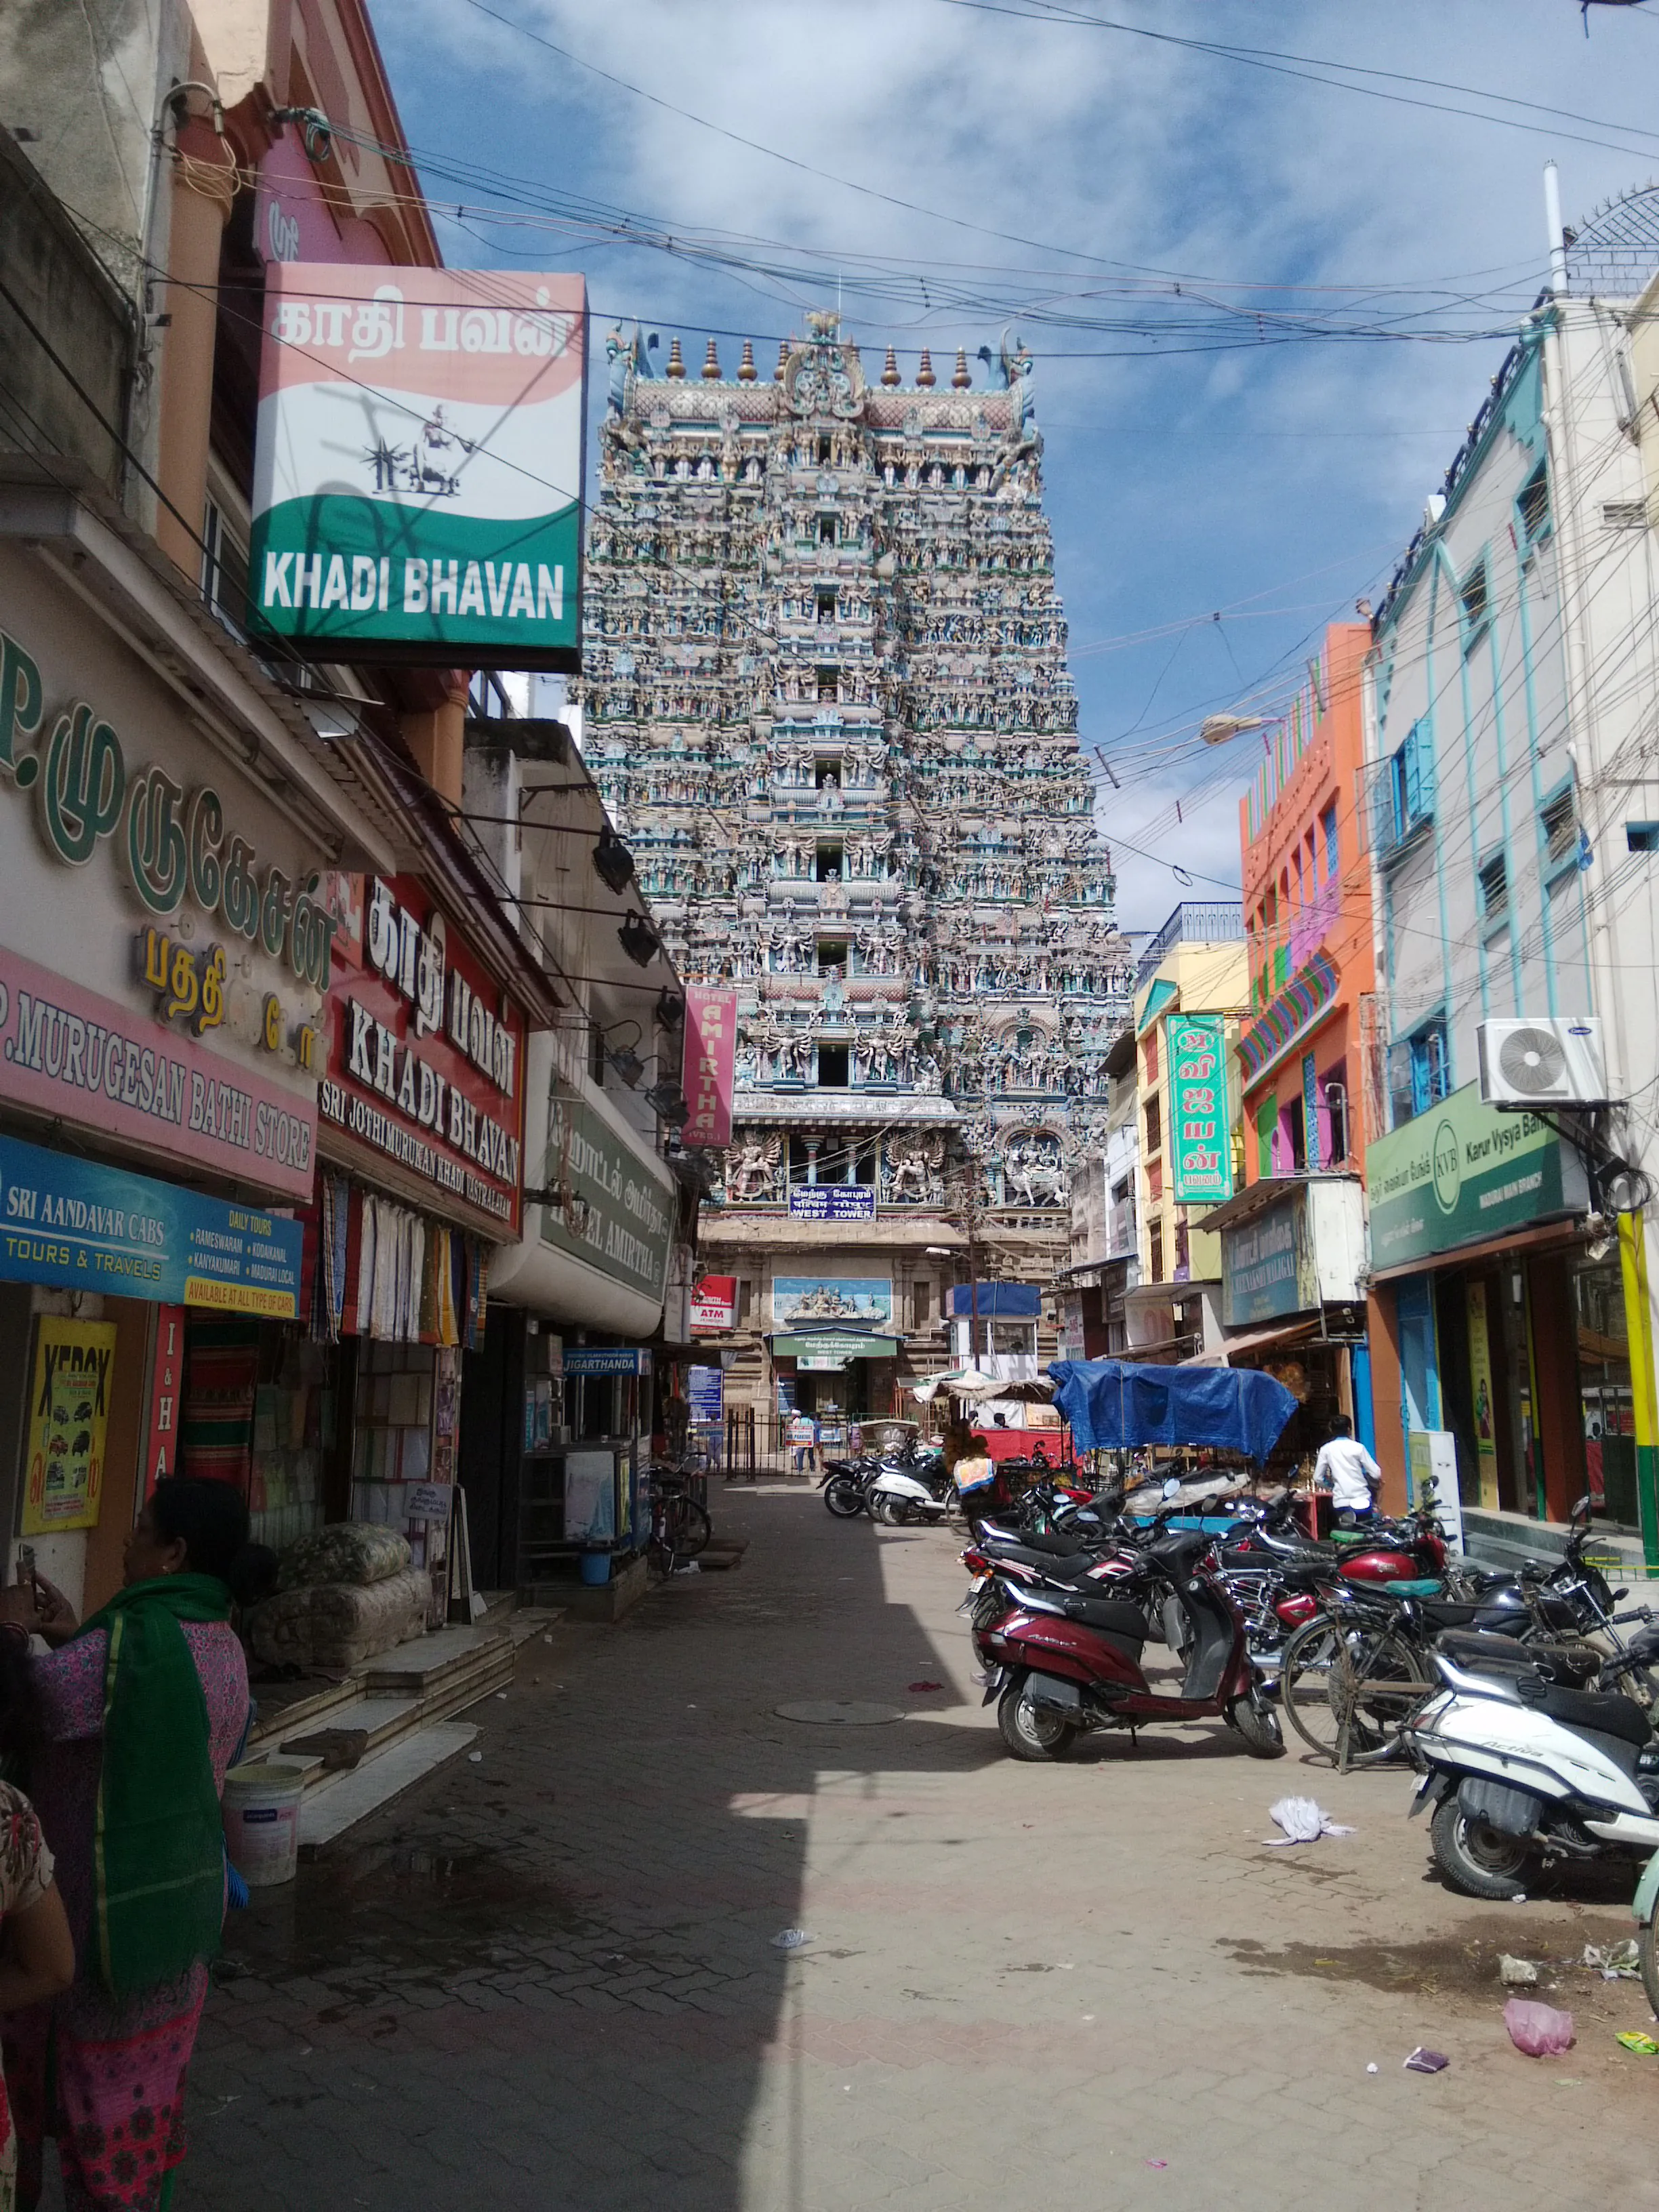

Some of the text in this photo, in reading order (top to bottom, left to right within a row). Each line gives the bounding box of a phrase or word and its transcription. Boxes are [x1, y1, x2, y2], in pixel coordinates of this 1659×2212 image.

[272, 284, 576, 364] காதி பவன்
[264, 551, 565, 619] KHADI BHAVAN
[369, 876, 516, 1099] காதி பவன்
[694, 991, 731, 1004] HOTEL
[695, 1004, 722, 1128] AMIRTHA
[349, 997, 445, 1136] KHADI
[449, 1086, 520, 1187] BHAVAN
[188, 1069, 253, 1149] BATHI
[255, 1099, 311, 1173] STORE
[1179, 1052, 1221, 1170] விஜயன்
[321, 1079, 347, 1124] SRI
[437, 1155, 466, 1197] KHADI
[1466, 1137, 1491, 1164] Karur
[1492, 1123, 1521, 1155] Vysya
[1183, 1170, 1222, 1186] பவனம்
[1436, 1148, 1458, 1178] KVB
[793, 1187, 872, 1200] மேற்கு கோபுரம்
[6, 1186, 165, 1247] SRI AANDAVAR CABS
[229, 1210, 272, 1237] DAILY TOURS
[792, 1209, 871, 1218] WEST TOWER
[5, 1237, 162, 1281] TOURS & TRAVELS
[195, 1228, 243, 1254] RAMESWARAM
[605, 1220, 654, 1281] AMIRTHA
[194, 1252, 295, 1285] KANYAKUMARI MADURAI LOCAL
[188, 1282, 293, 1313] AVAILABLE AT ALL TYPE OF CARS
[700, 1309, 723, 1318] ATM
[563, 1359, 634, 1372] JIGARTHANDA
[1480, 1741, 1544, 1757] Activa
